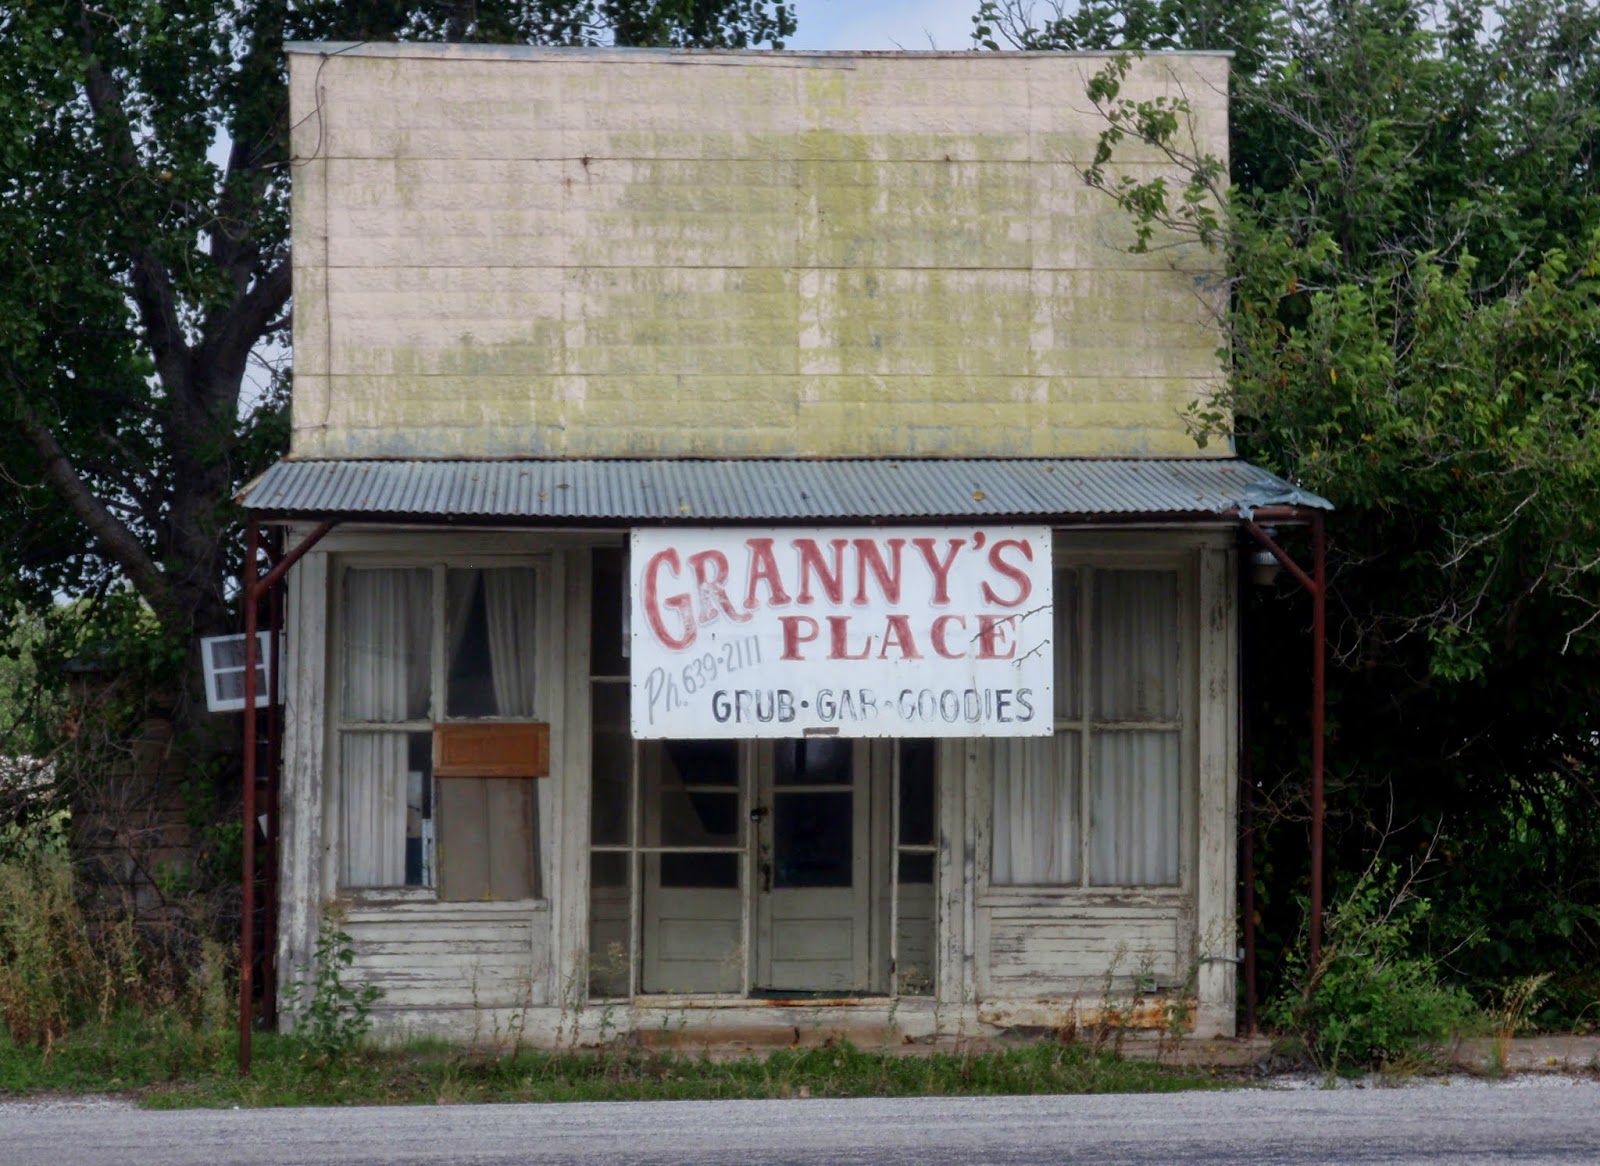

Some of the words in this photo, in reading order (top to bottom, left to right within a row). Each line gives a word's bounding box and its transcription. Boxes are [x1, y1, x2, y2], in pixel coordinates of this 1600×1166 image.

[643, 532, 1035, 650] GRANNY'S
[777, 614, 1018, 660] PLACE
[644, 667, 688, 725] Ph.
[711, 689, 797, 724] GRUB
[898, 688, 1035, 723] GOODIES
